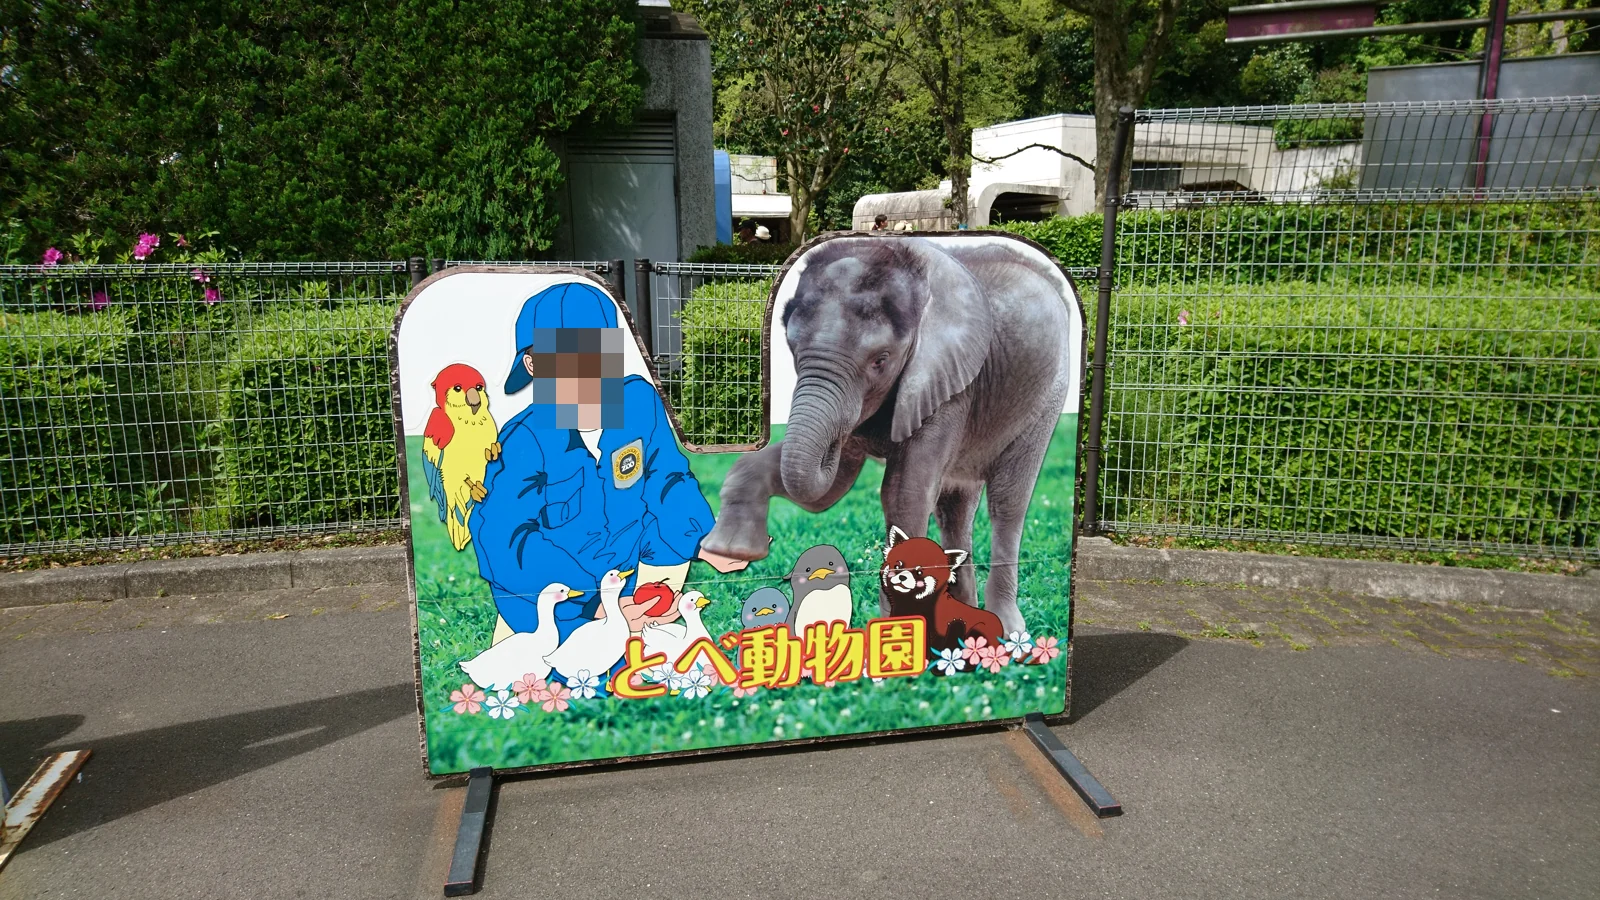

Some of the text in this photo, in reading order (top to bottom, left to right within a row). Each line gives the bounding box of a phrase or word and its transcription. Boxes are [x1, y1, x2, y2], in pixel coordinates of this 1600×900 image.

[613, 616, 926, 698] とべ動物園
